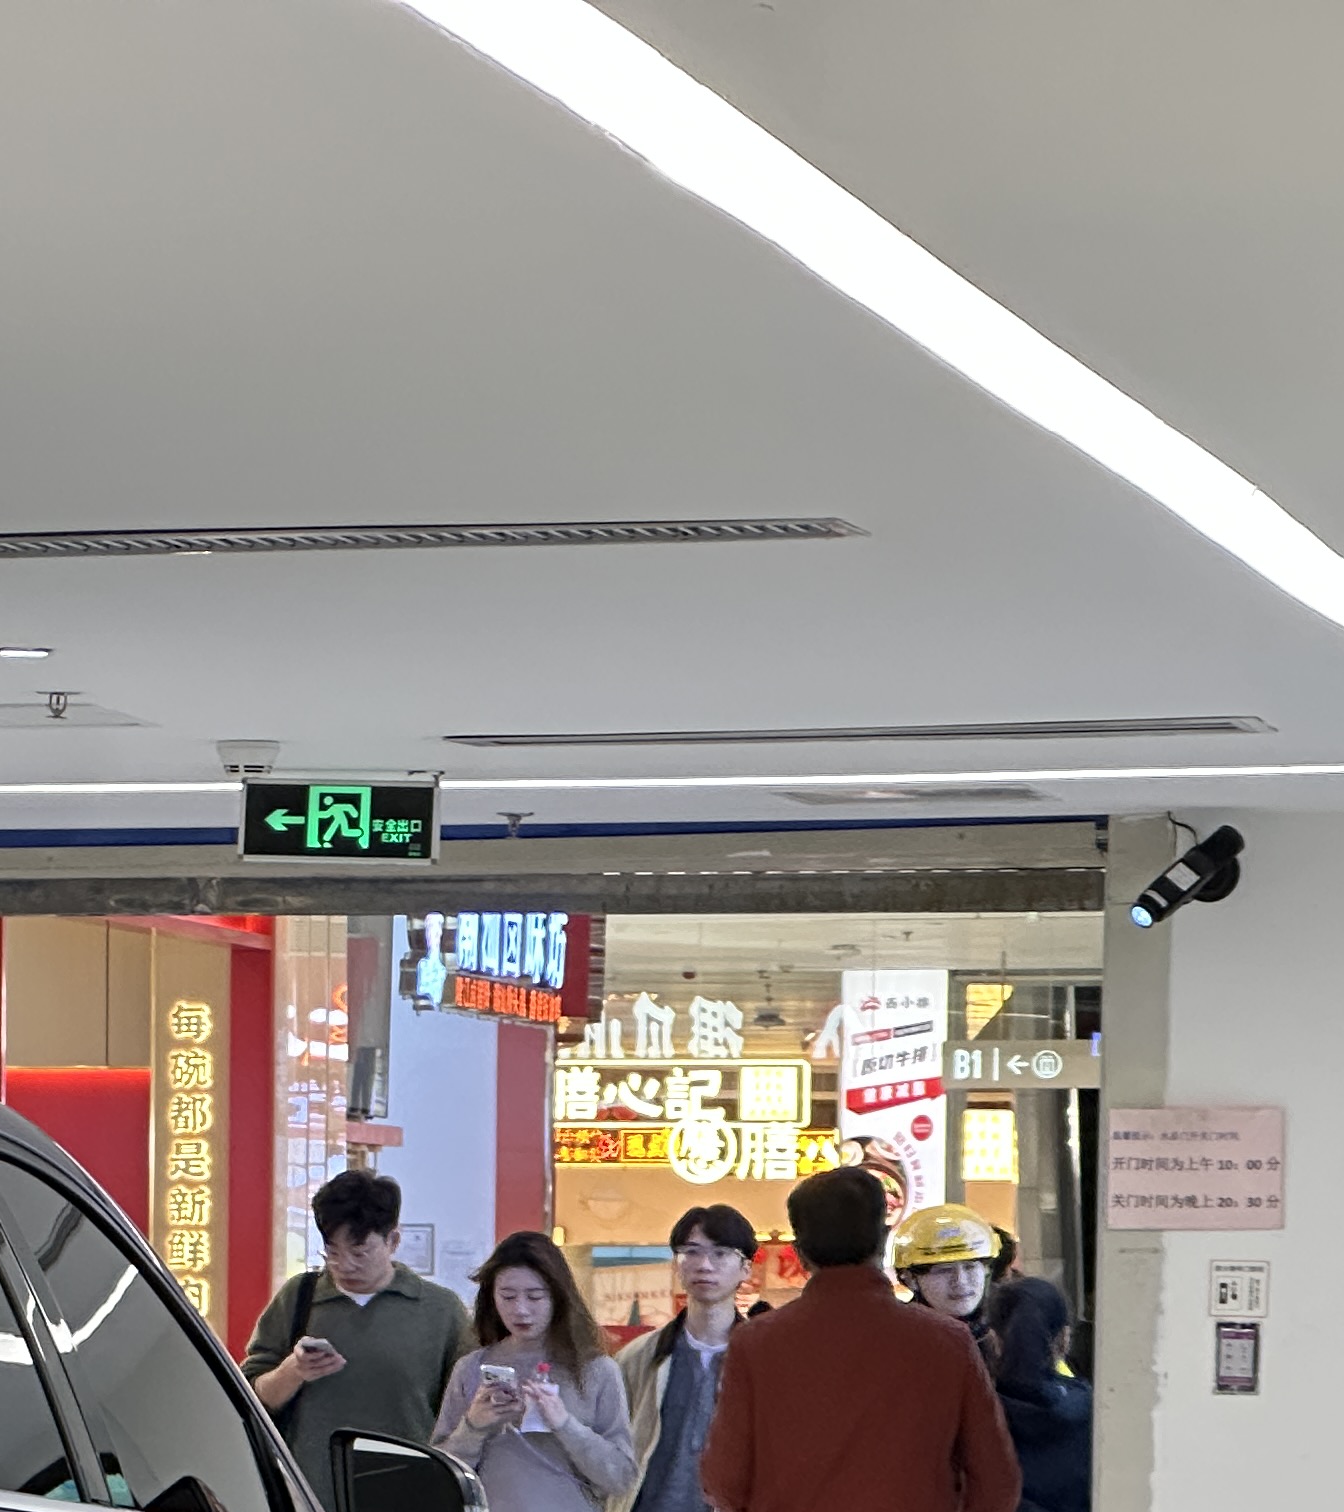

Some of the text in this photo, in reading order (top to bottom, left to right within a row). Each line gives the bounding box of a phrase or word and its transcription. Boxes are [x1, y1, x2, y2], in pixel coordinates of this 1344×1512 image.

[372, 819, 422, 832] 安全出口
[381, 832, 413, 843] EXIT
[953, 1049, 982, 1079] B1
